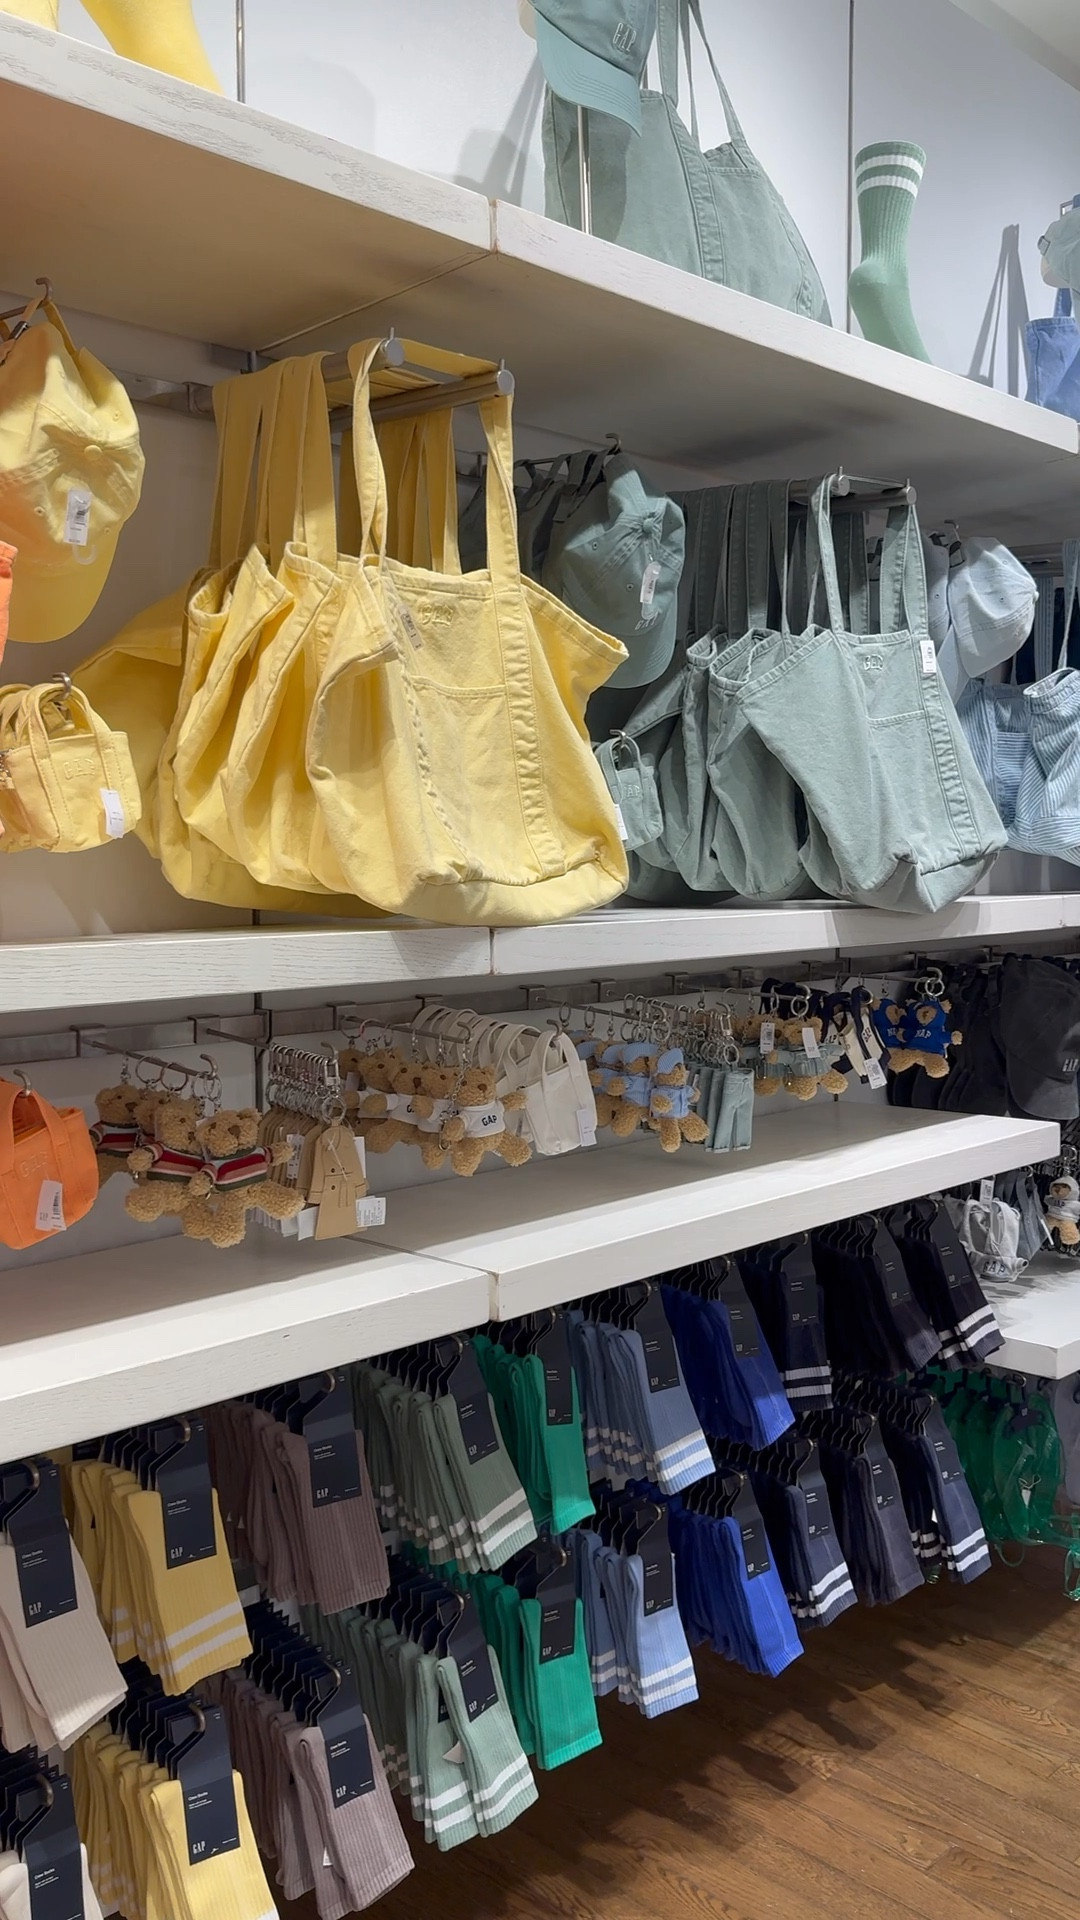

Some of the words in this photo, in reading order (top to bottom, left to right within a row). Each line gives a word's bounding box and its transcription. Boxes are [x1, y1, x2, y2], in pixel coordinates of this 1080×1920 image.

[612, 22, 637, 52] GAP
[481, 1114, 498, 1127] GAP
[983, 1260, 1006, 1274] GAP
[316, 1487, 329, 1500] GAP
[170, 1546, 184, 1560] GAP
[28, 1601, 42, 1616] GAP
[335, 1784, 347, 1799] GAP
[192, 1840, 206, 1855] GAP
